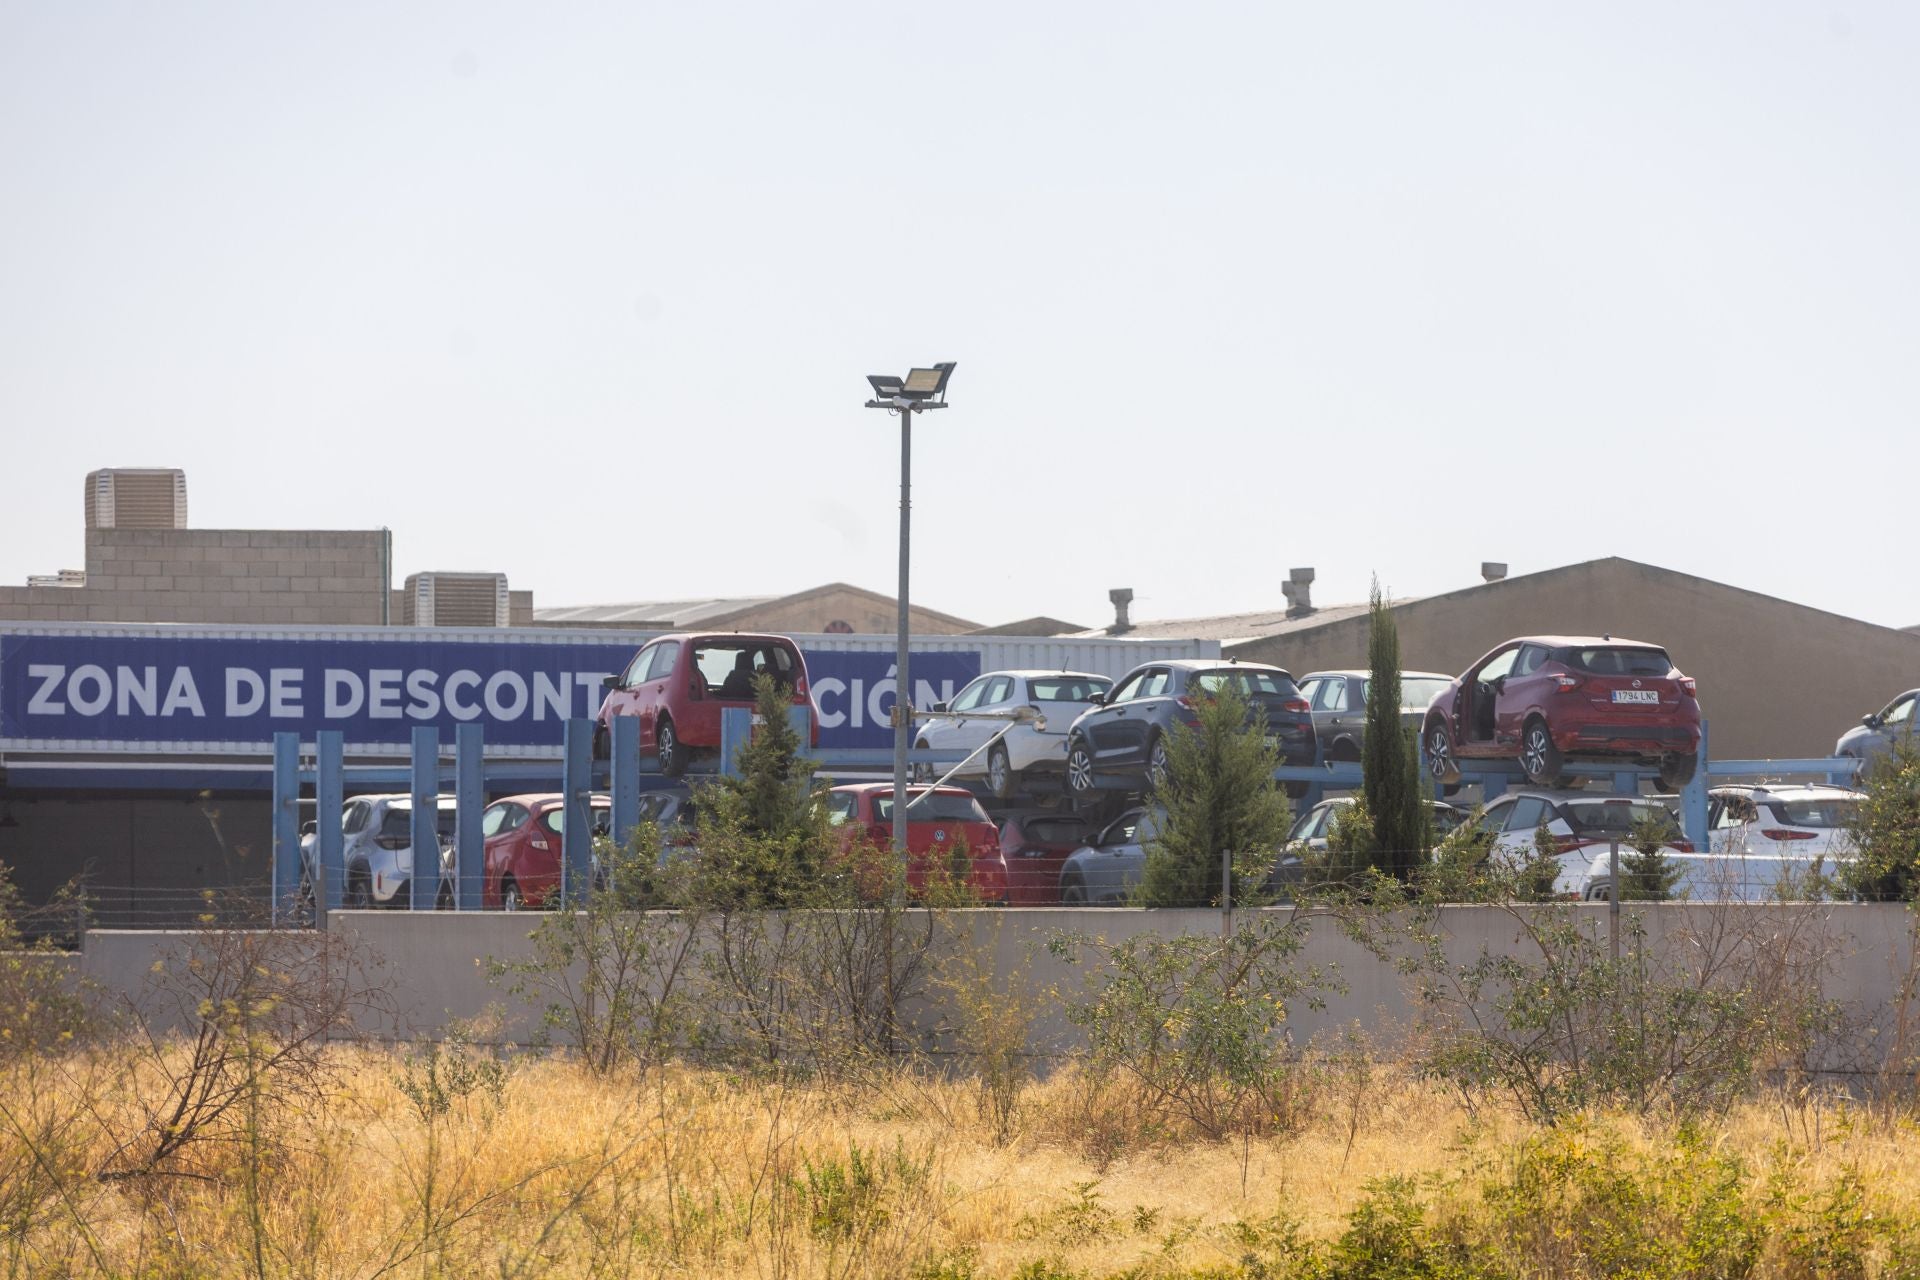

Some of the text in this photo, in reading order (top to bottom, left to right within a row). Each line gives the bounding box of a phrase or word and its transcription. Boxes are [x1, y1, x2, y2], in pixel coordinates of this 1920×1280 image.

[27, 664, 953, 729] ZONA DE DESCONTCIÓN
[1618, 691, 1657, 701] 1794 LNC
